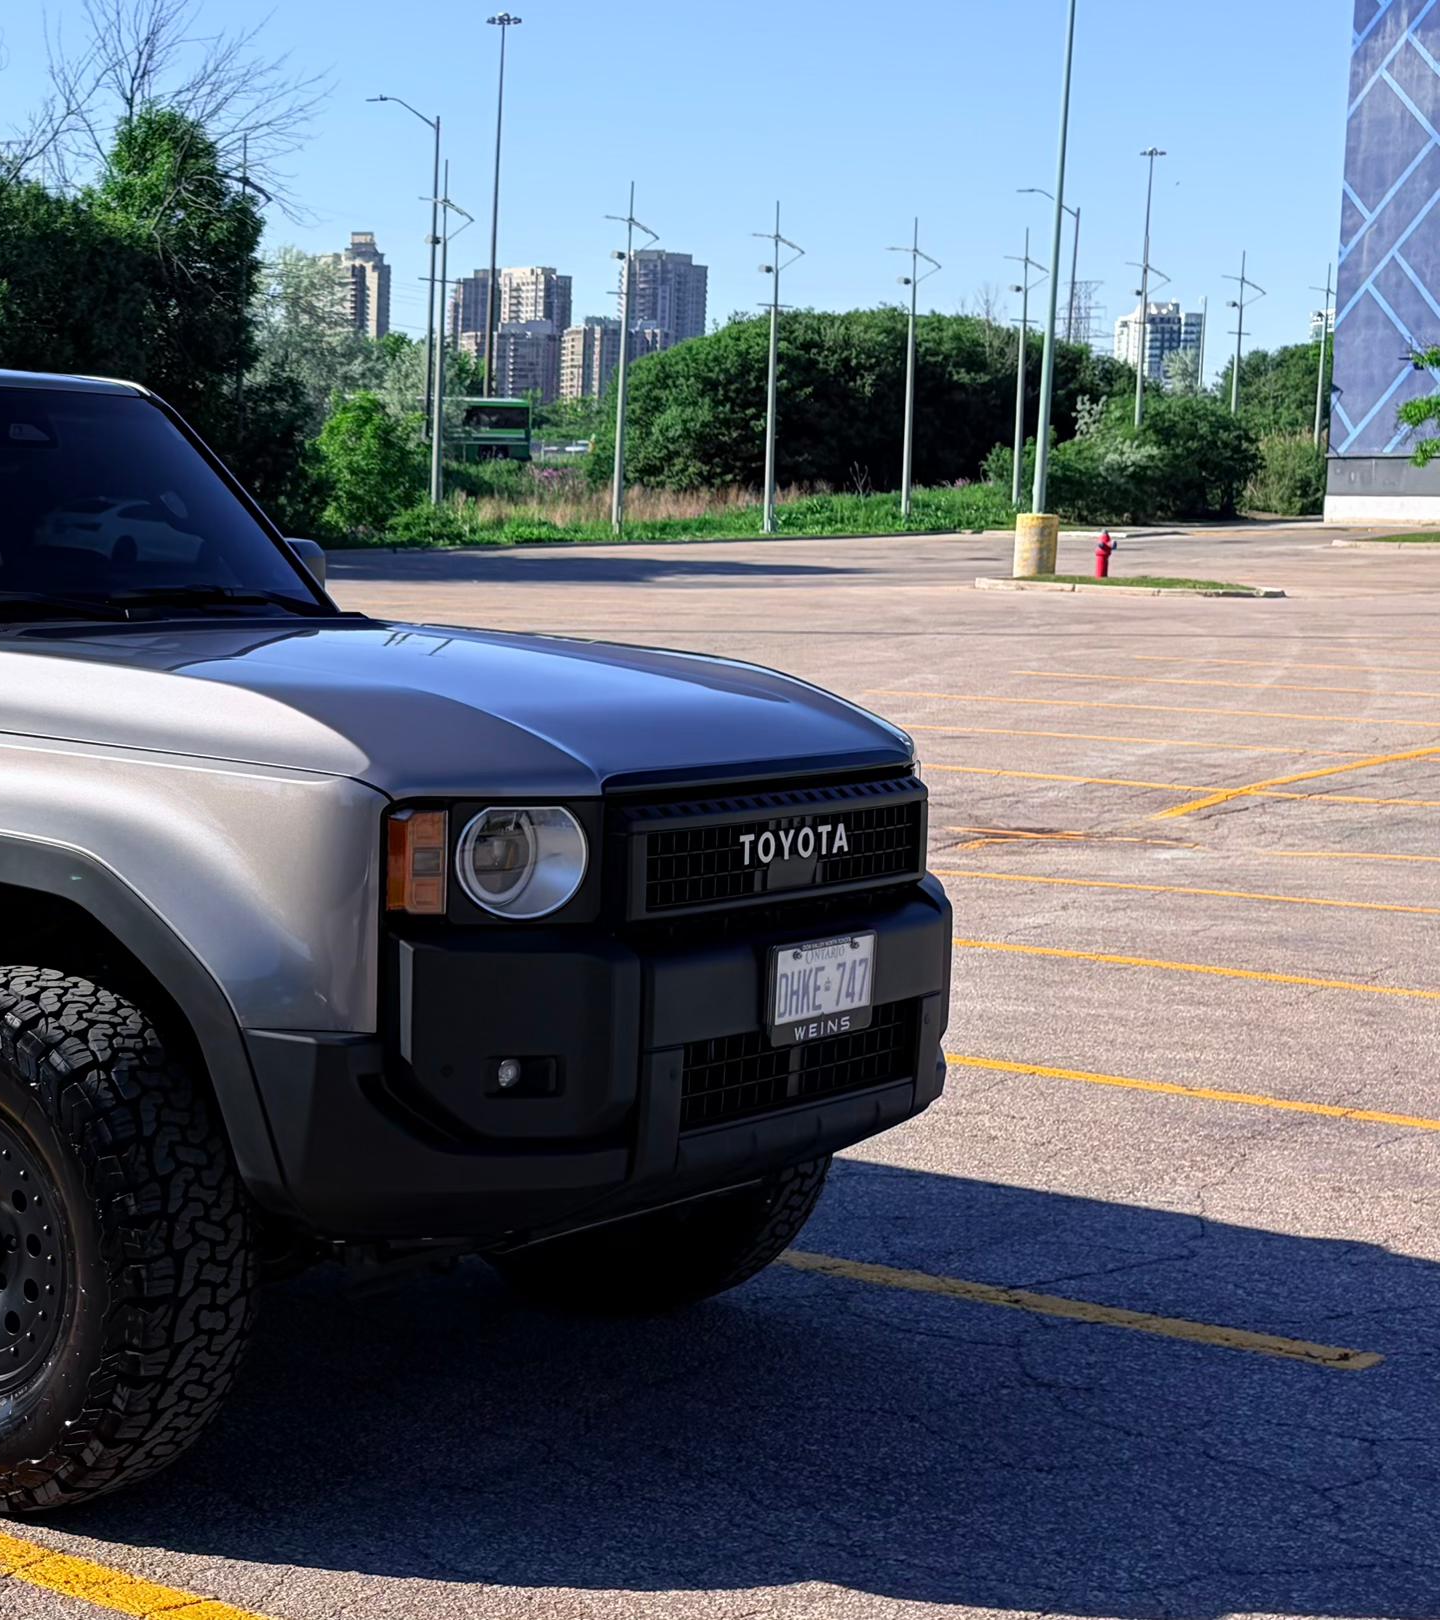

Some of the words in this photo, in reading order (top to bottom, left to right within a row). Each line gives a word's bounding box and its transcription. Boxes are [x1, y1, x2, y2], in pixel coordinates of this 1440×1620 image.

[740, 823, 849, 865] TOYOTA
[805, 945, 845, 965] ONTARIO
[794, 1016, 850, 1041] WEINS
